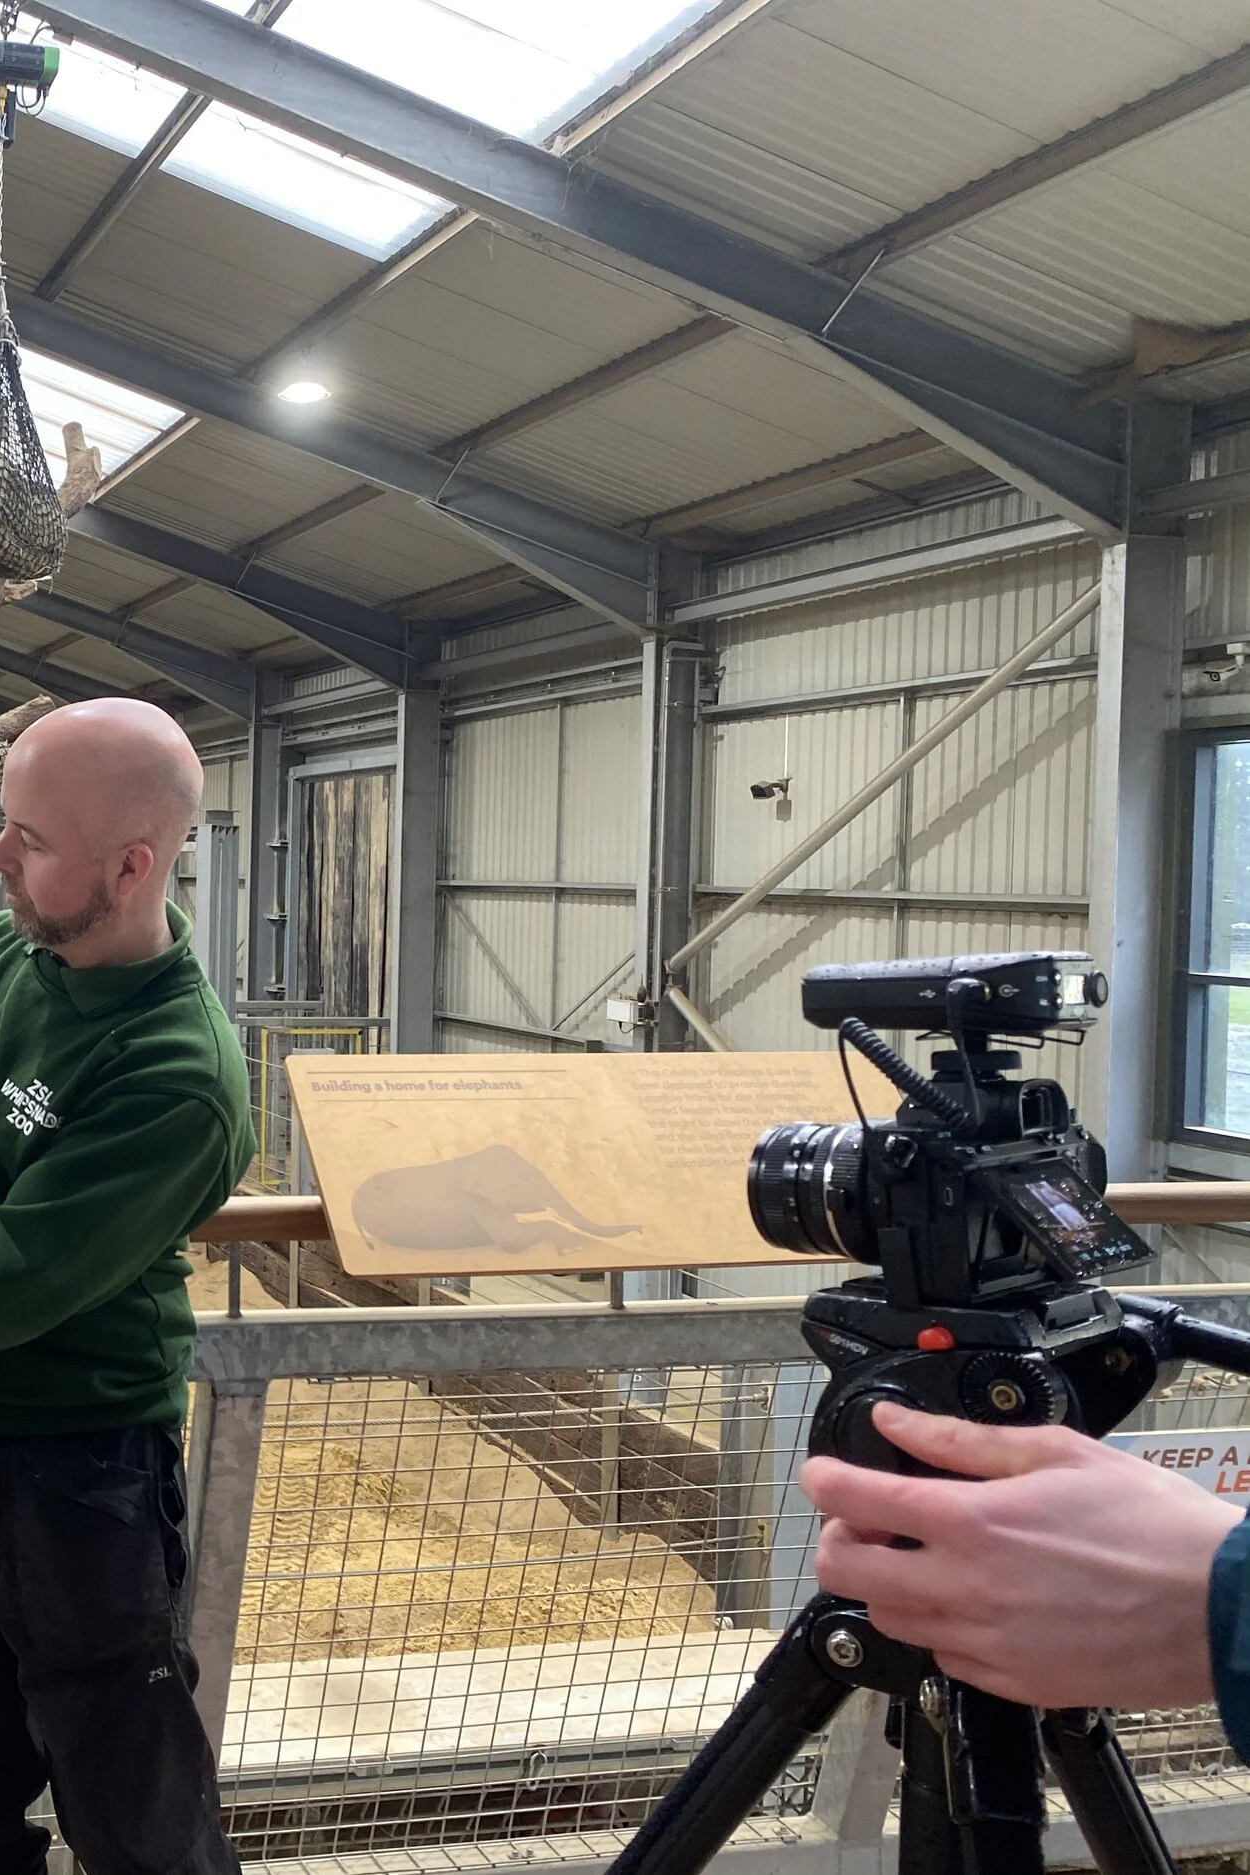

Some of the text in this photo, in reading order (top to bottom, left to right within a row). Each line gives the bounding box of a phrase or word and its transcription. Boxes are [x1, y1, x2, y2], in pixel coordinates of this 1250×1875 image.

[27, 1078, 54, 1107] ZSL
[311, 1078, 523, 1093] Building a home for elephants
[6, 1107, 34, 1136] ZOO
[1144, 1448, 1214, 1468] KEEP
[1218, 1446, 1239, 1467] A
[149, 1666, 172, 1683] ZSL
